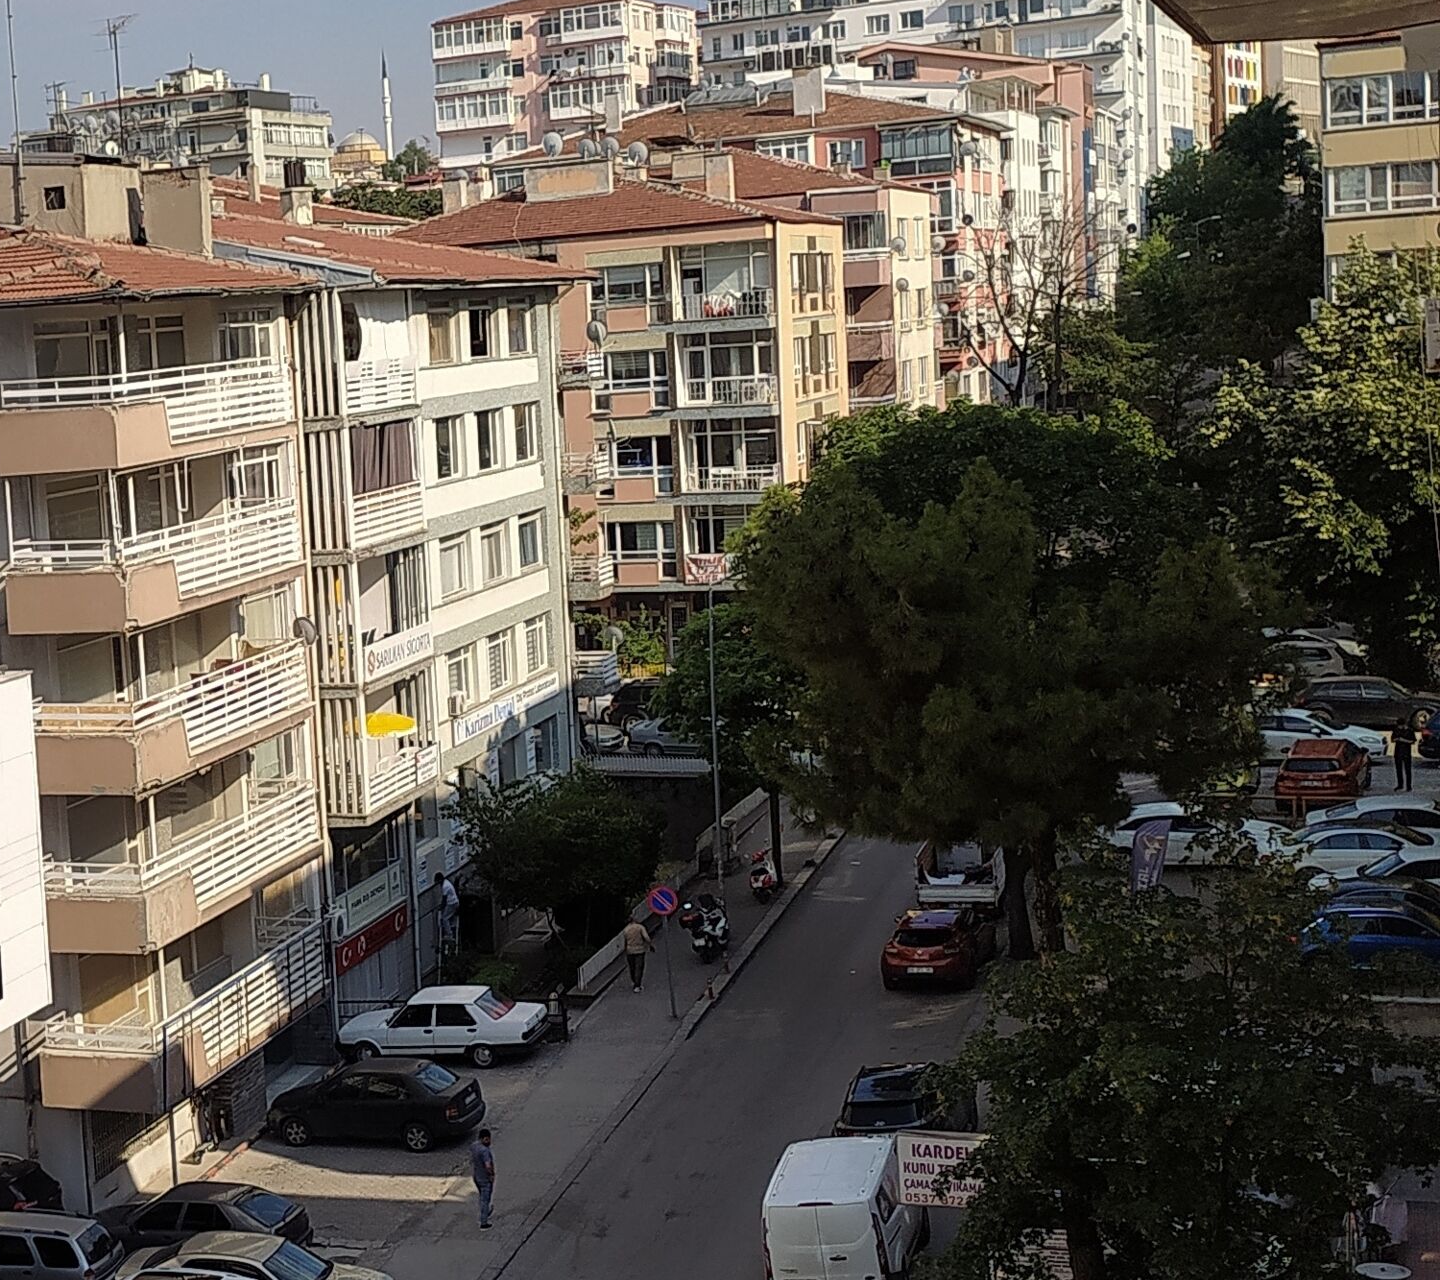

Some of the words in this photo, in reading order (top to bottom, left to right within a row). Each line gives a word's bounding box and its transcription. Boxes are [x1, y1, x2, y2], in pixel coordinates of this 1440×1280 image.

[911, 1143, 969, 1161] KARDEL
[903, 1161, 935, 1175] KURU
[905, 1192, 936, 1204] 0537
